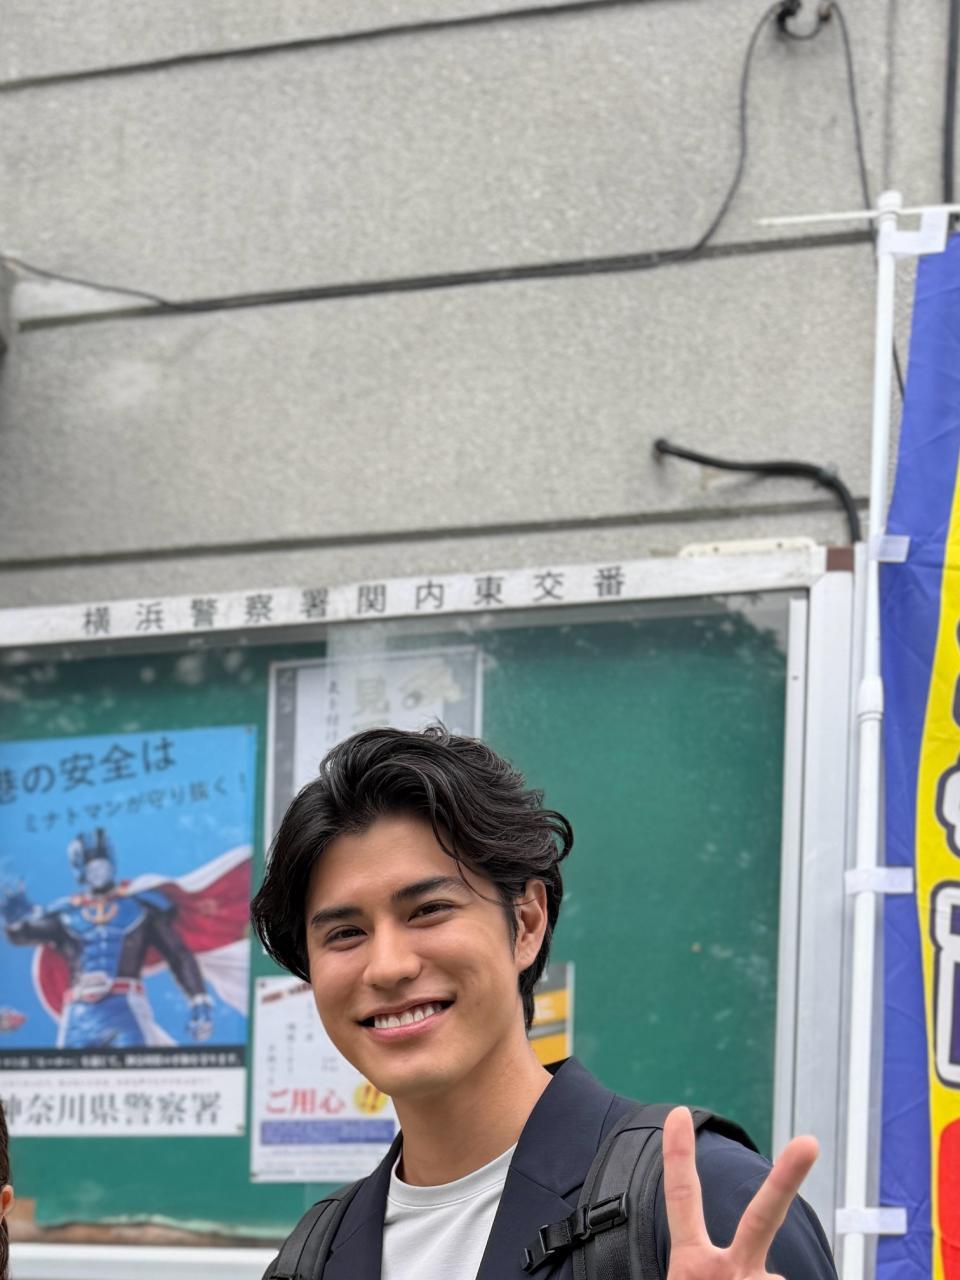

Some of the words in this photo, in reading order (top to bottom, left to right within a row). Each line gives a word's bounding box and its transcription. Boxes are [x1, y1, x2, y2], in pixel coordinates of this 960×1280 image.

[82, 566, 627, 635] 横浜警察署関内東交番
[266, 1087, 347, 1115] ご用心
